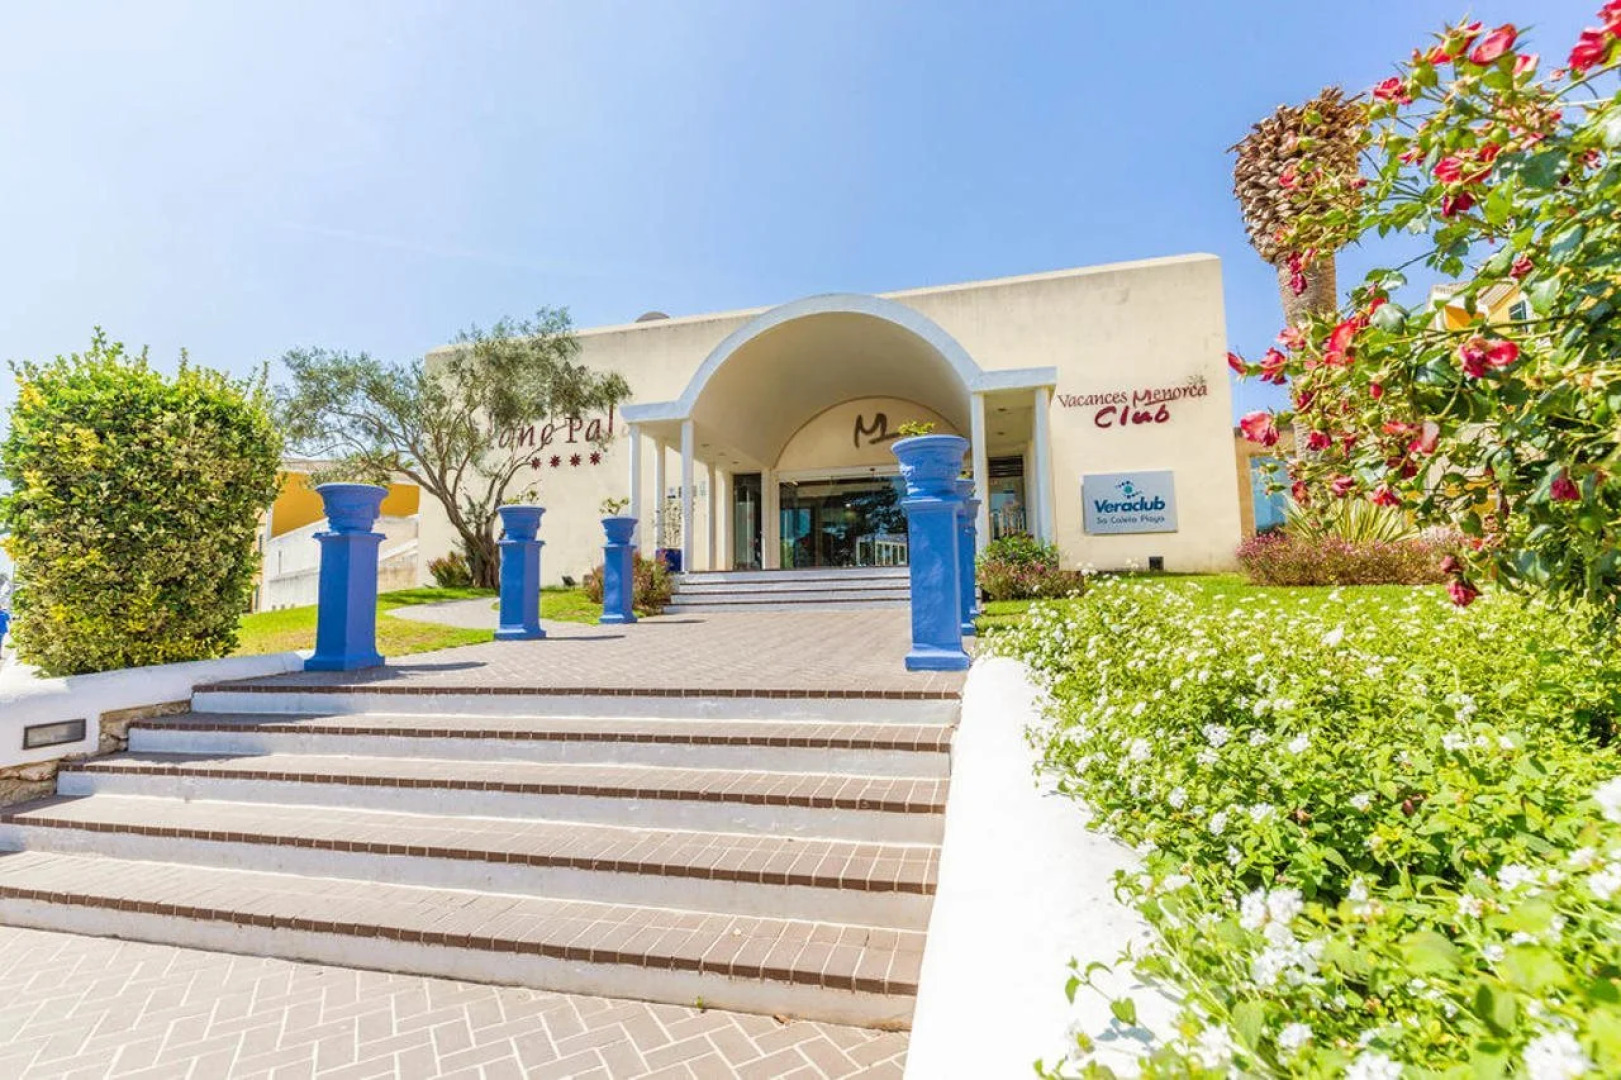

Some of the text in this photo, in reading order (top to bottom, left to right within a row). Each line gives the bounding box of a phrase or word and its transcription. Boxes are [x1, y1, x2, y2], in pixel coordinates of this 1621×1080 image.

[1057, 383, 1208, 408] Vacances Menorca
[1094, 403, 1170, 429] Club
[1094, 495, 1166, 513] Veraclub
